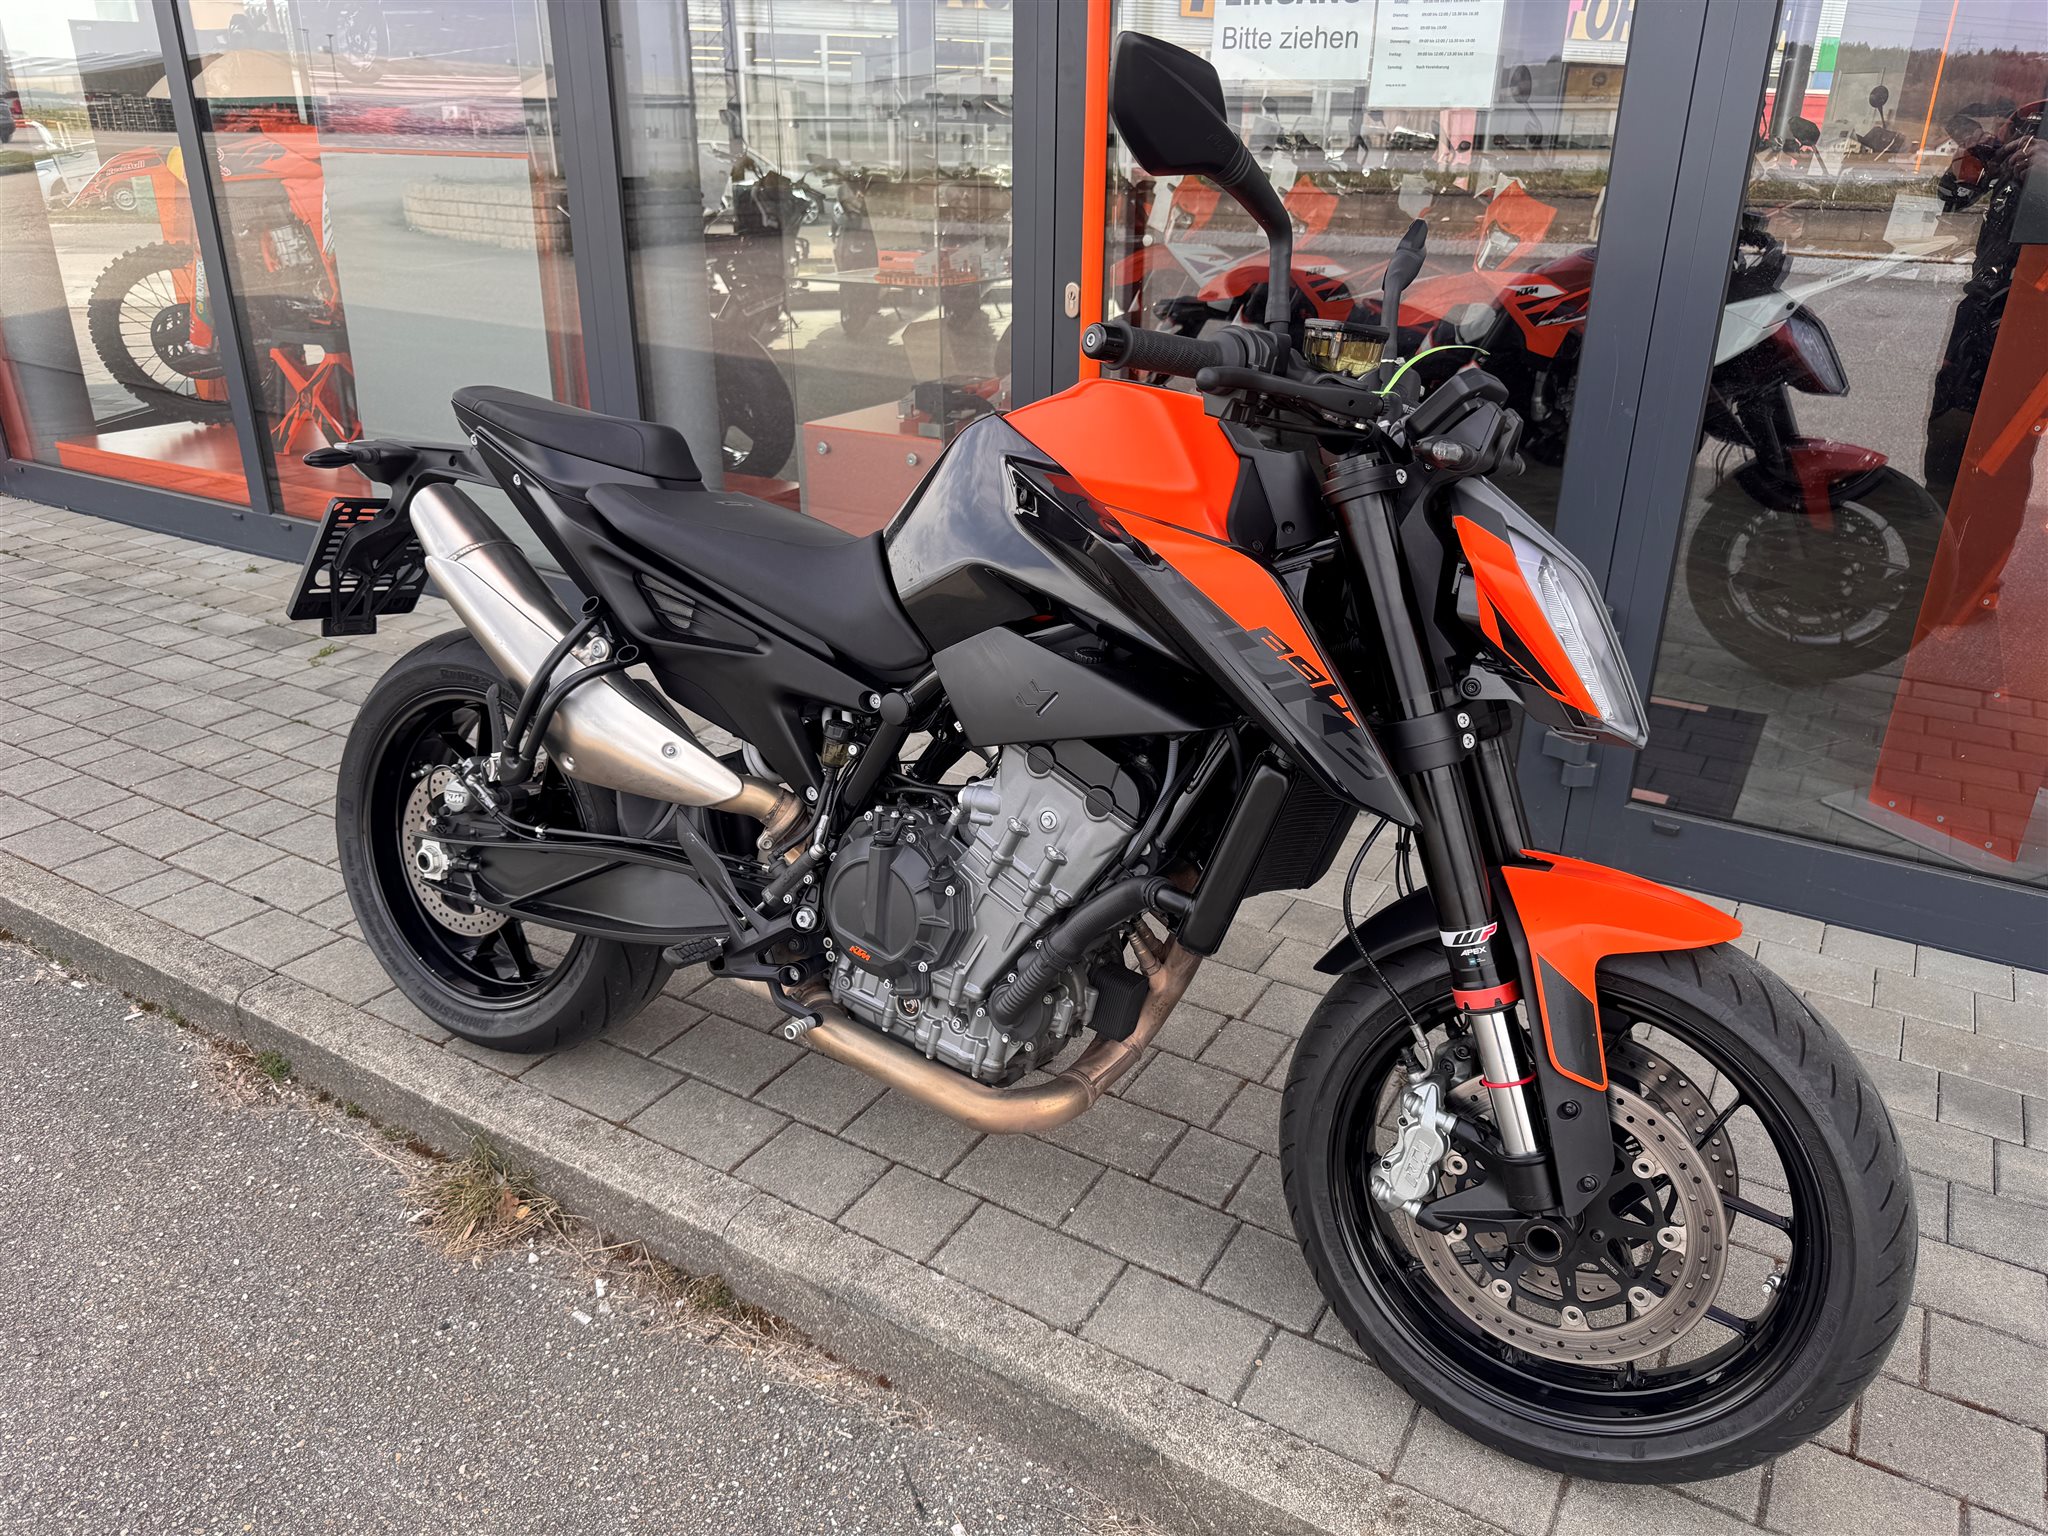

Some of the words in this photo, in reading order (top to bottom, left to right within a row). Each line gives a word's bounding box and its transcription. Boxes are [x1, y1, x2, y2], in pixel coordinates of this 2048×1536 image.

[1222, 26, 1272, 50] Bitte
[1279, 25, 1359, 49] ziehen
[1515, 285, 1540, 297] KTM
[849, 945, 871, 961] KTM
[1461, 946, 1487, 956] APEX
